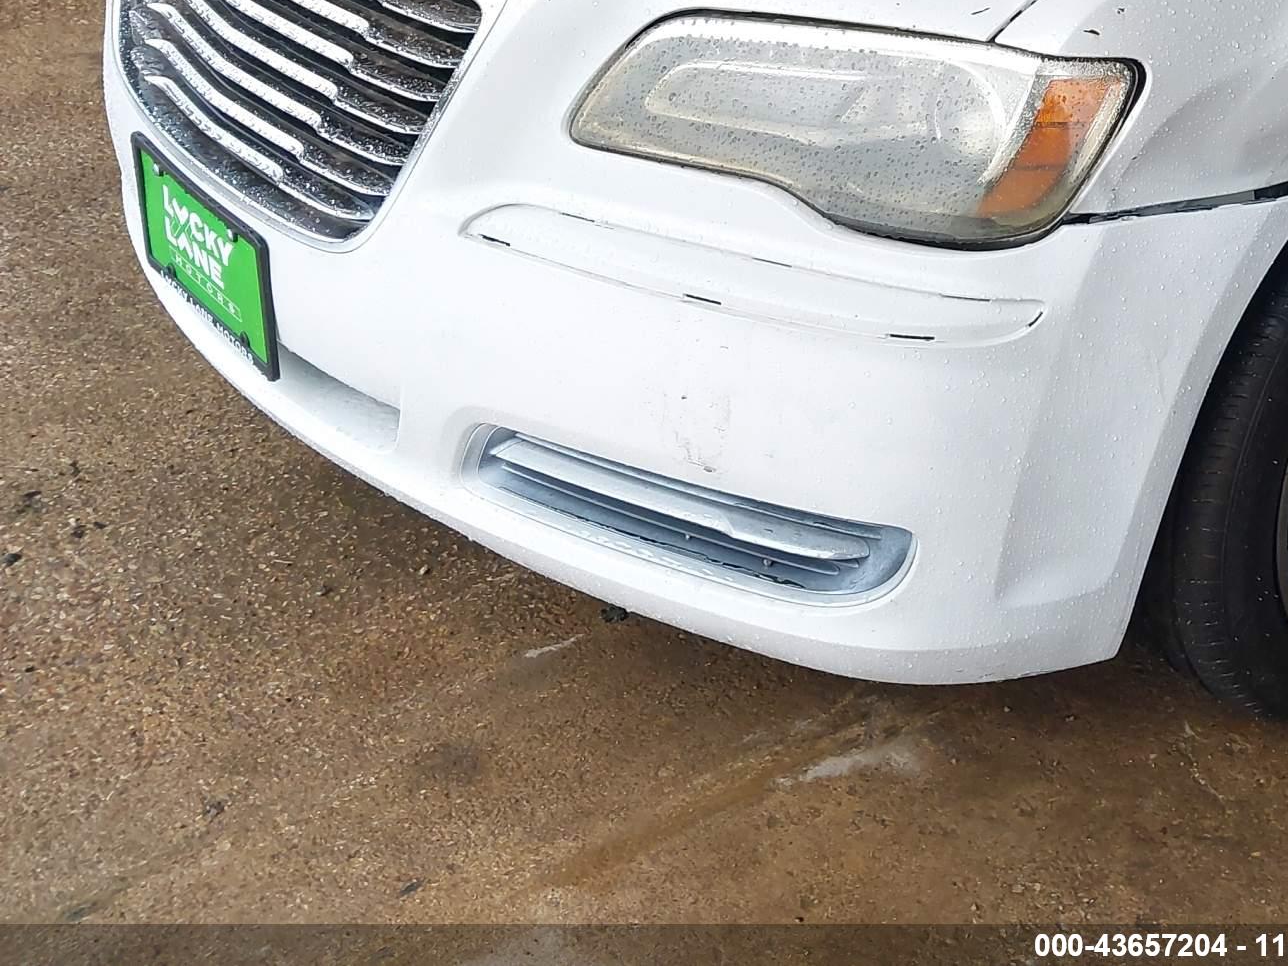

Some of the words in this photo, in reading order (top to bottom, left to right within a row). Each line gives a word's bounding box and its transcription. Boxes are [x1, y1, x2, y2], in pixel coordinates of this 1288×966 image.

[162, 184, 234, 267] LUCKY
[164, 215, 226, 291] LANE
[175, 251, 237, 316] MOTORS
